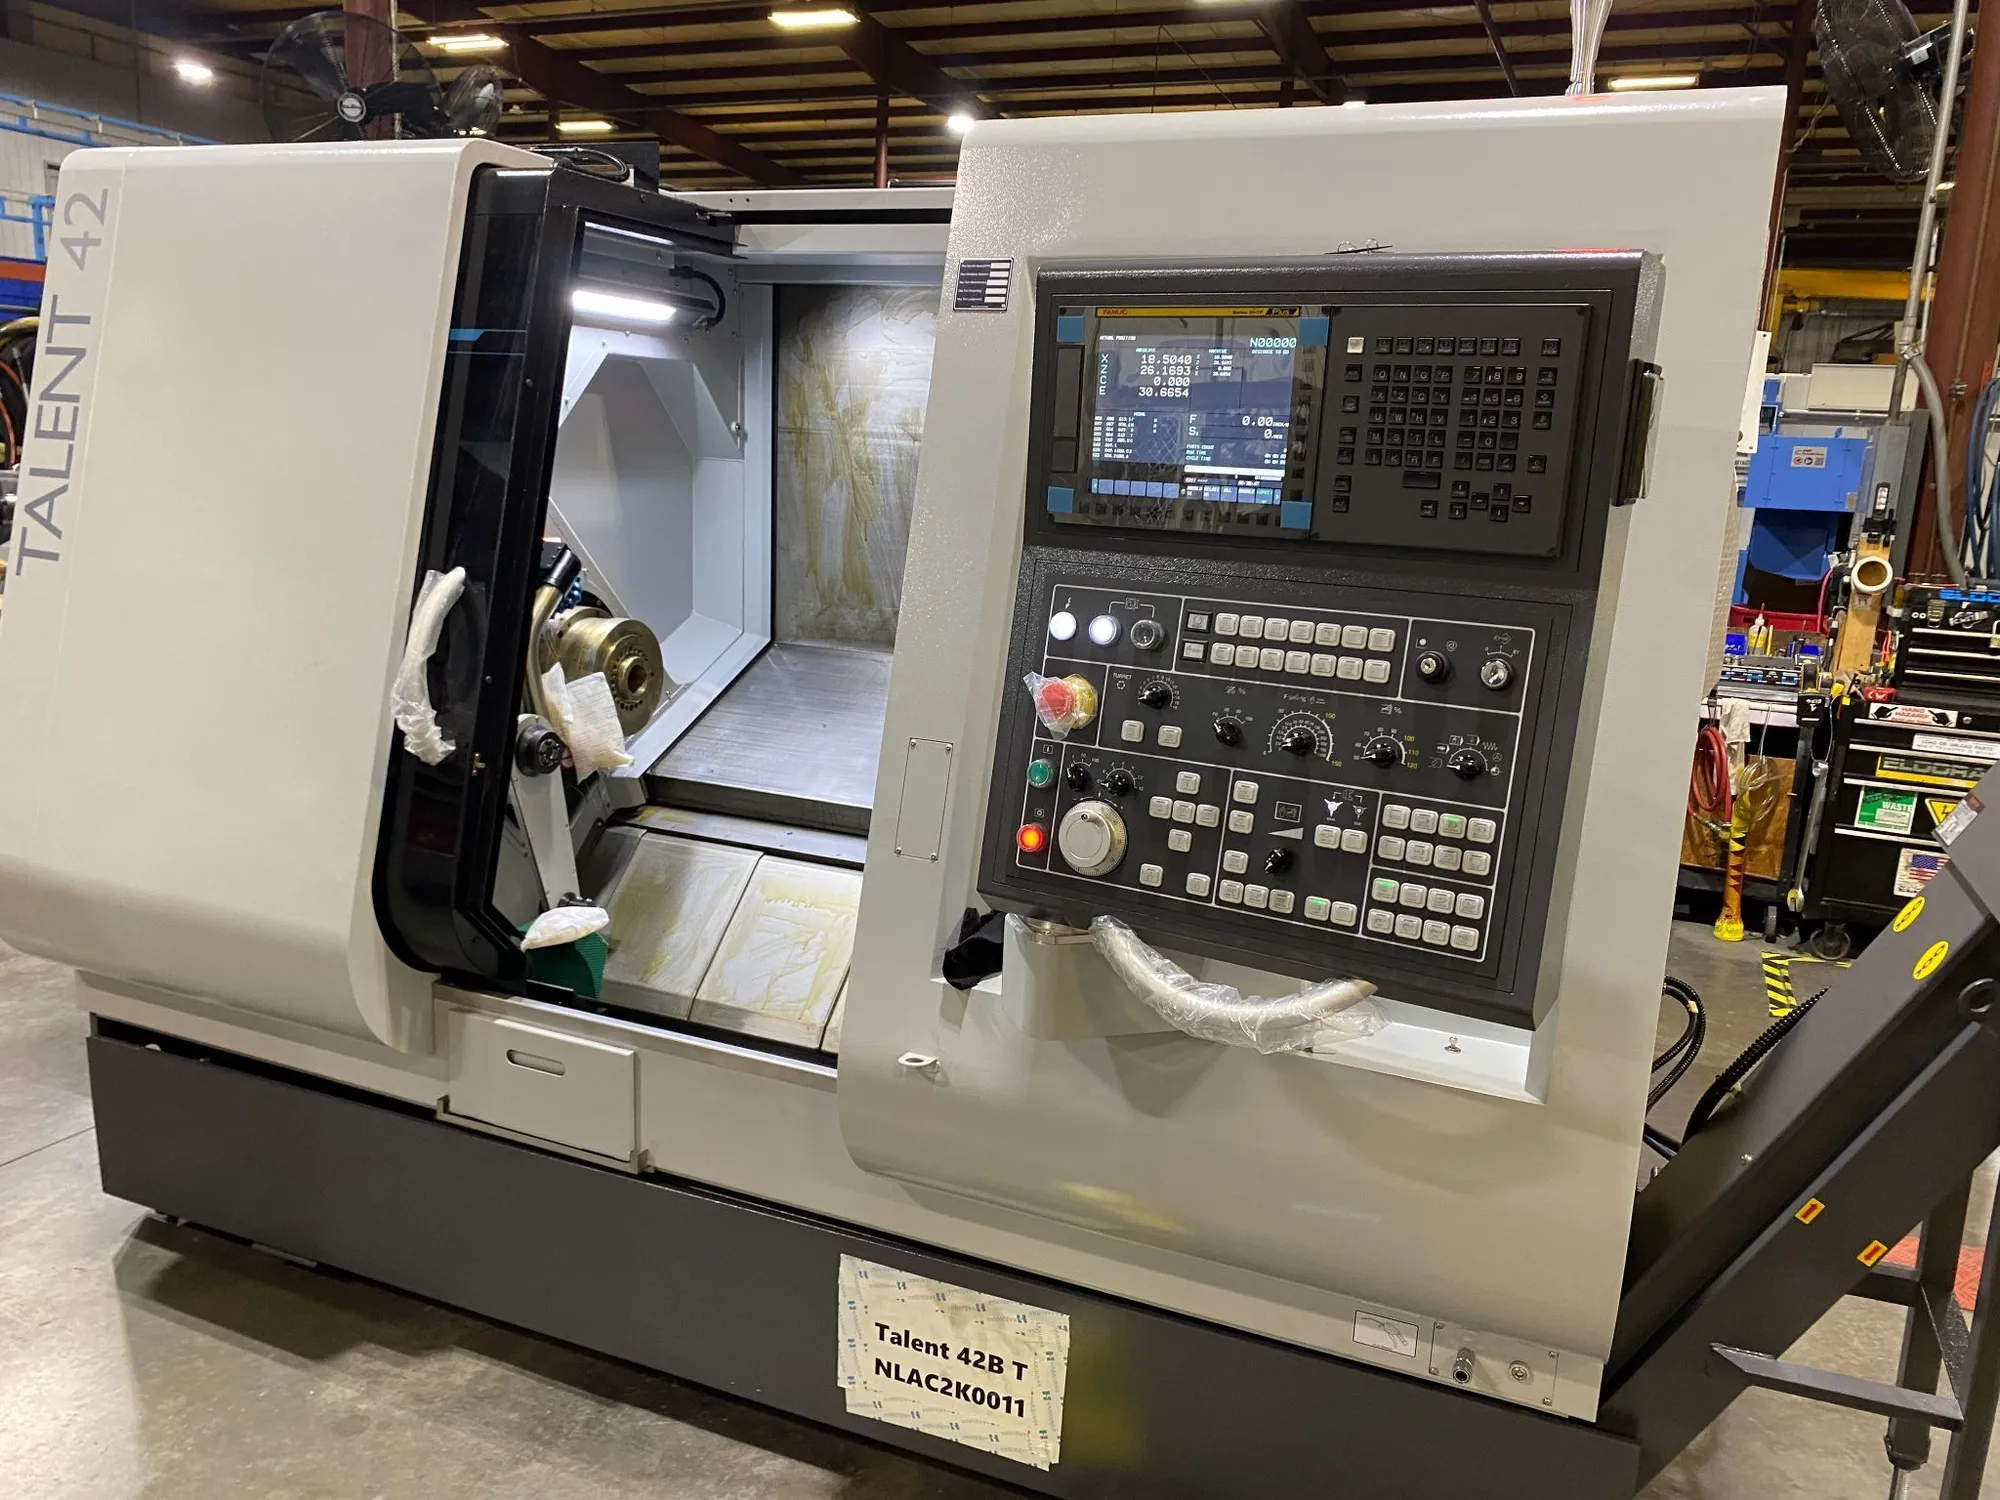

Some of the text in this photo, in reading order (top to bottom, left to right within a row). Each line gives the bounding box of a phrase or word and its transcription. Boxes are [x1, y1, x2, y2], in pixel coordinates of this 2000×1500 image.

[1250, 337, 1297, 348] N00000
[1101, 354, 1192, 365] X 18.5040
[1101, 365, 1191, 375] Z 26.1693
[15, 189, 109, 576] TALENT 42
[1100, 375, 1190, 386] C 0.000
[1099, 386, 1190, 398] E 30.6654
[1189, 414, 1197, 424] F
[1241, 415, 1273, 426] 0.00
[1882, 801, 1914, 812] WASTE
[875, 1322, 1028, 1380] Talent 42B T
[874, 1358, 1024, 1419] NLAC2K0011
